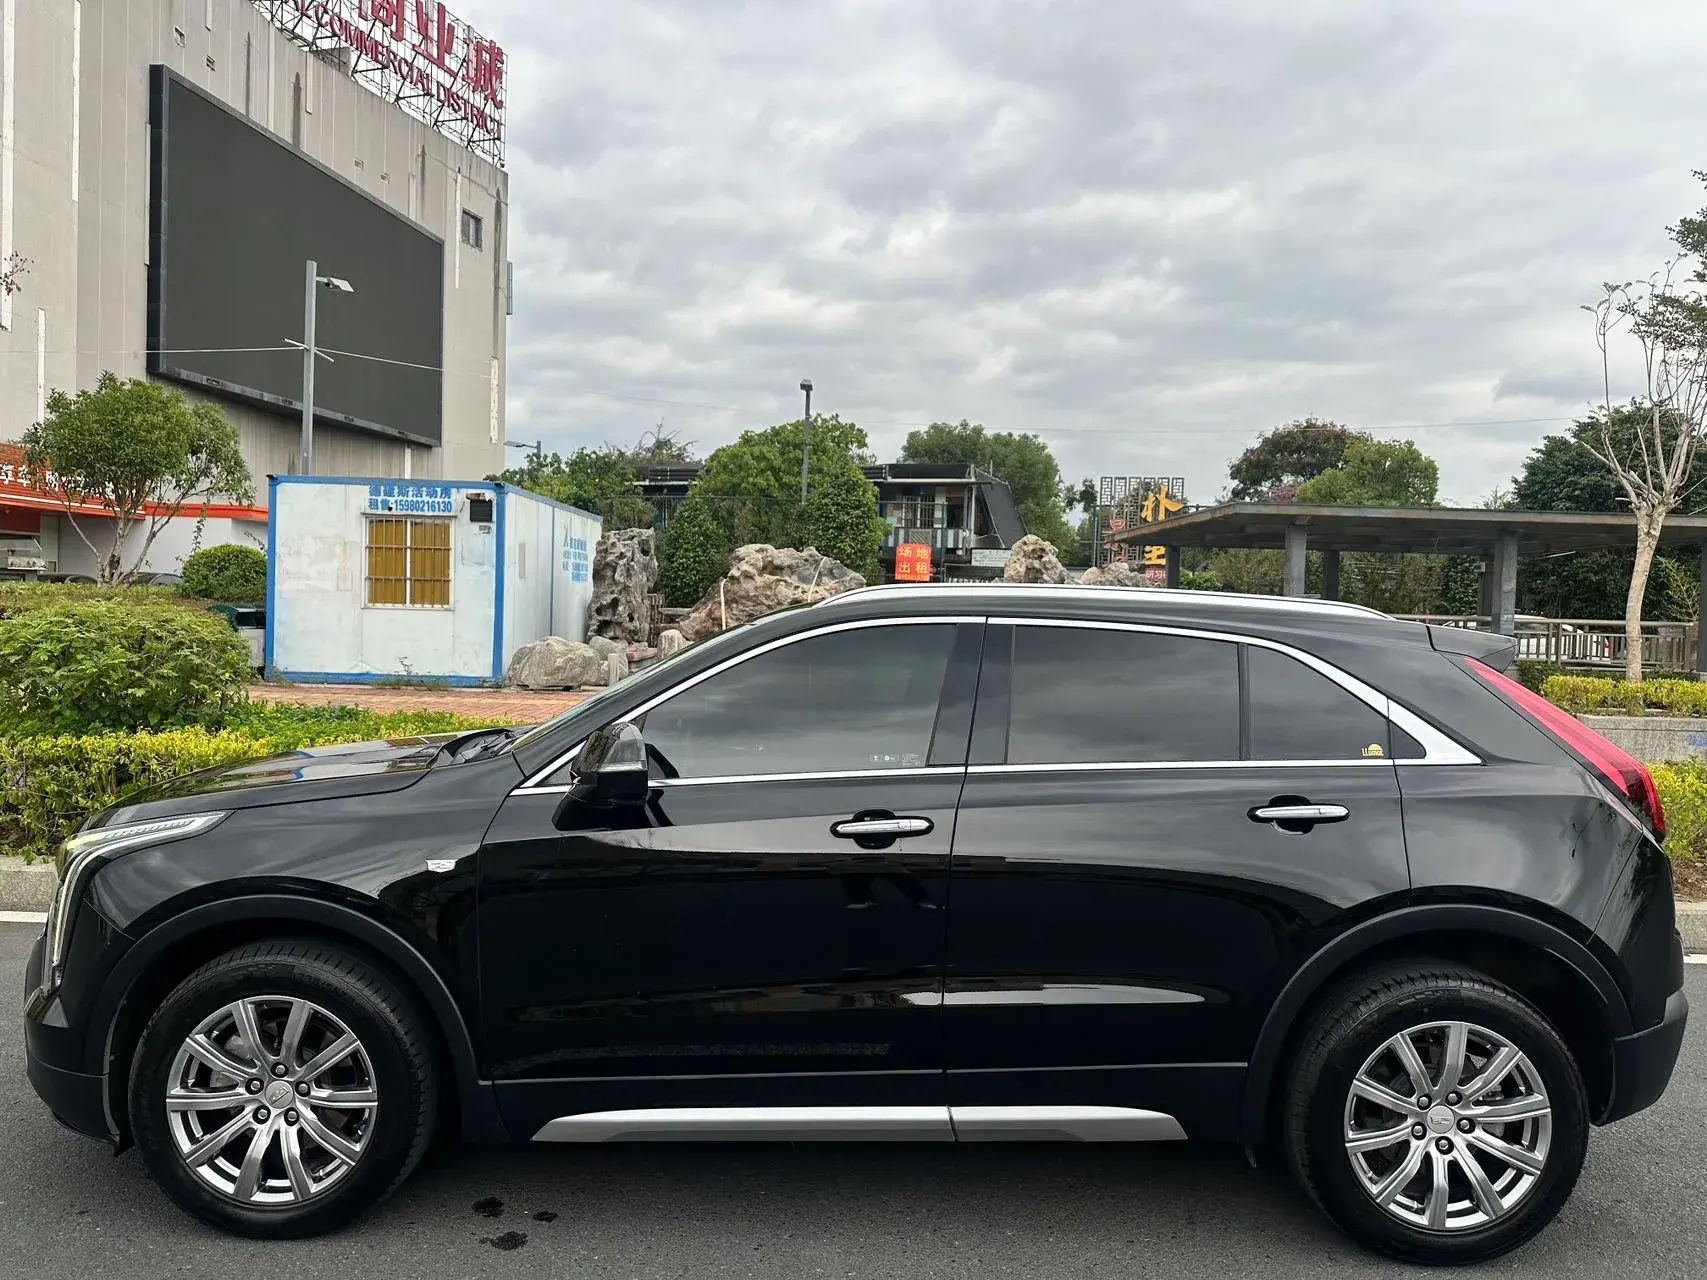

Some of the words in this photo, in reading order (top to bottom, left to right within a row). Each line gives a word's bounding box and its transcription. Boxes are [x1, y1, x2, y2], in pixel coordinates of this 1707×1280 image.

[315, 4, 433, 96] COMMERCIAL
[437, 81, 501, 138] DISTRICT
[899, 546, 928, 559] 场地
[899, 561, 927, 574] 出租
